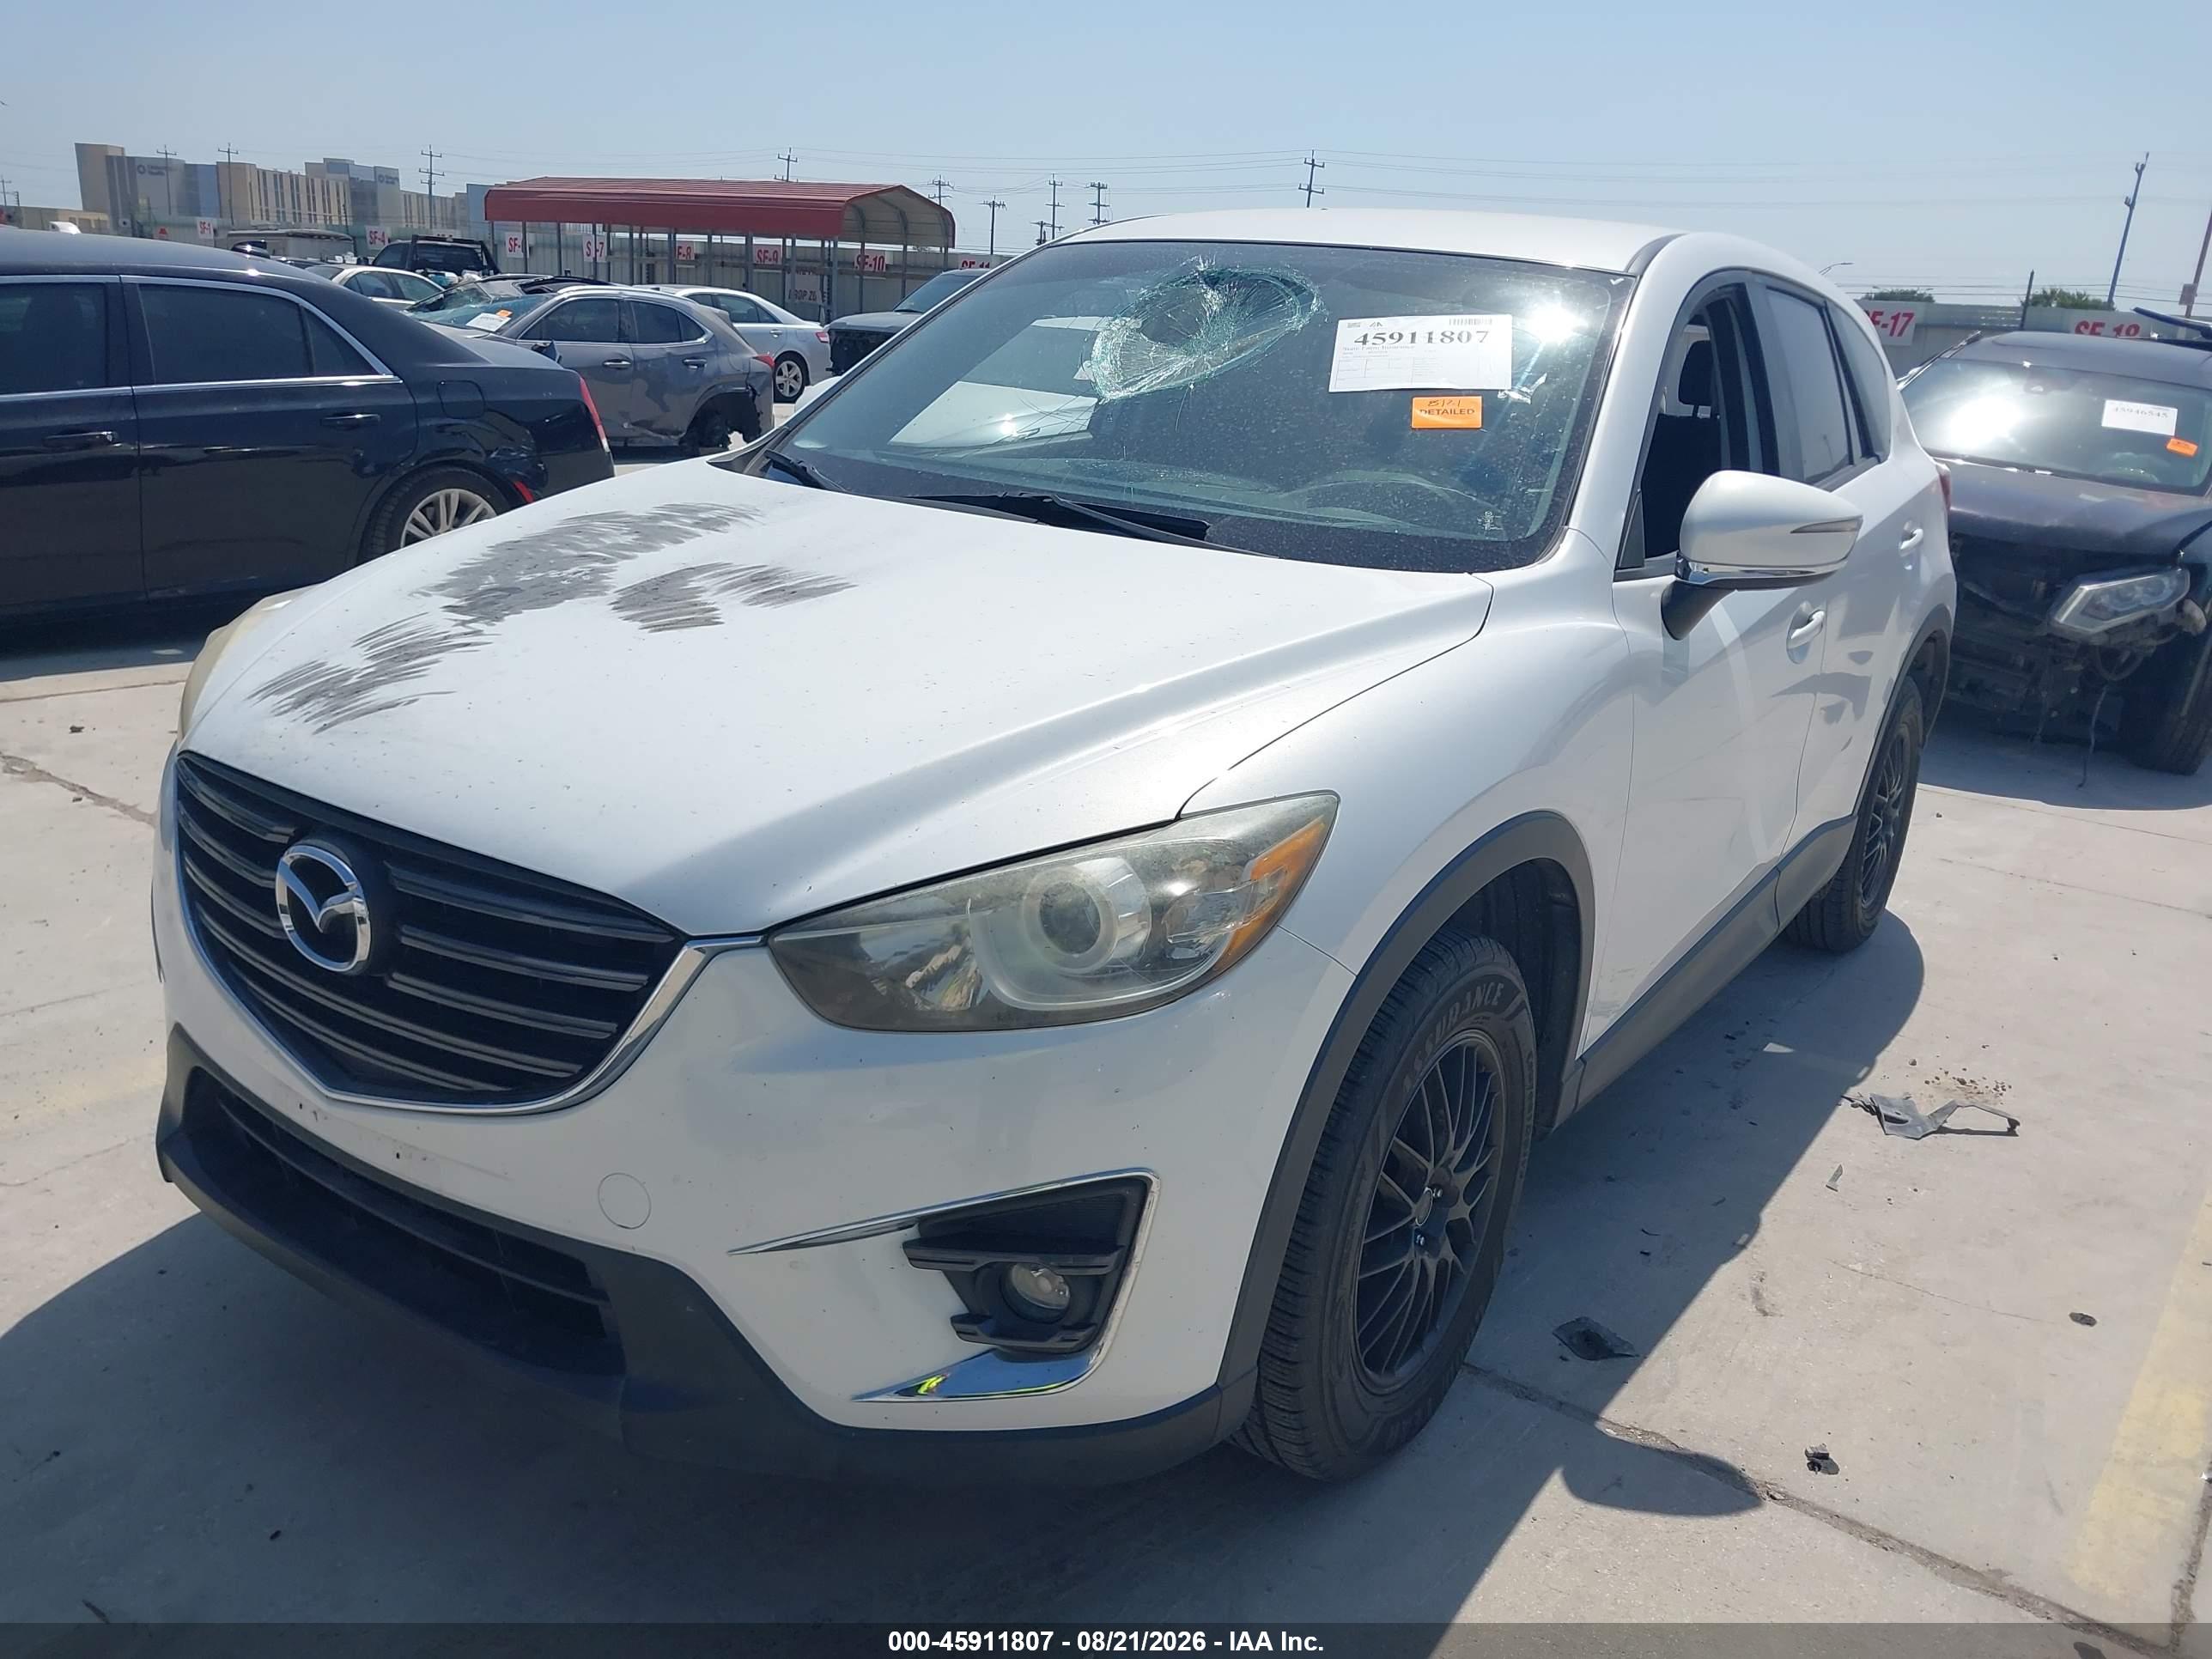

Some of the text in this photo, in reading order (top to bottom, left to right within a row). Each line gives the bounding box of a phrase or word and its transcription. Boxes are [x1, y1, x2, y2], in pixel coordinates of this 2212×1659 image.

[369, 230, 386, 245] SF-4
[586, 240, 605, 258] S-7
[1869, 310, 1914, 337] F-17
[1353, 330, 1490, 345] 45911807
